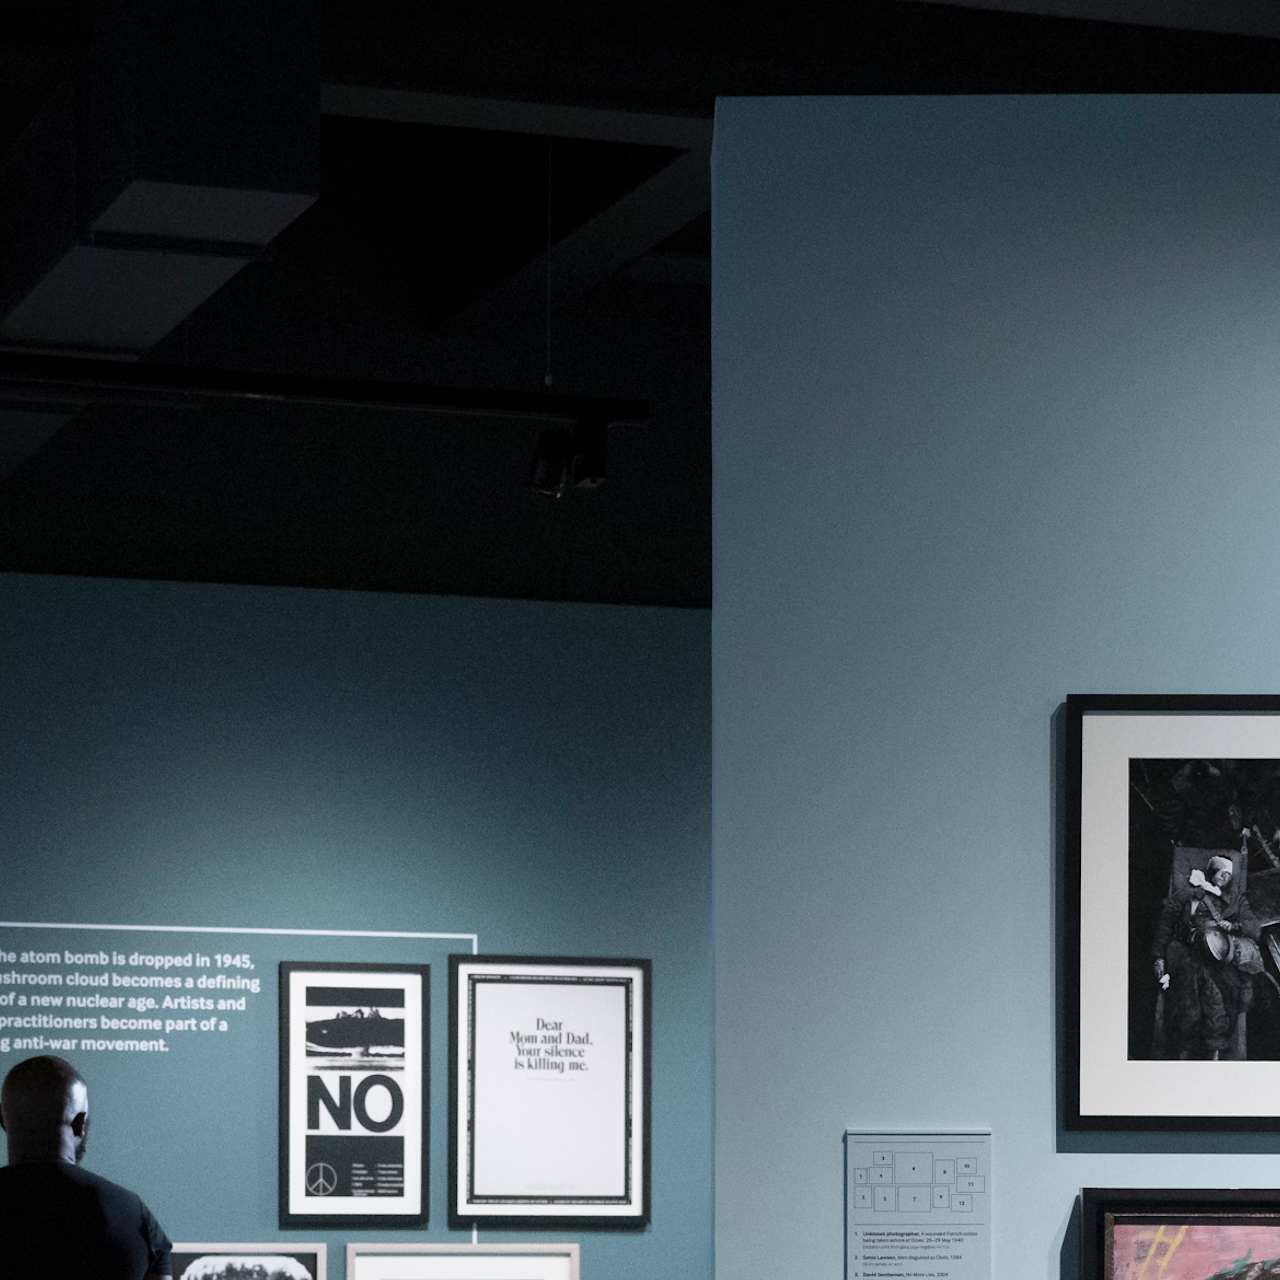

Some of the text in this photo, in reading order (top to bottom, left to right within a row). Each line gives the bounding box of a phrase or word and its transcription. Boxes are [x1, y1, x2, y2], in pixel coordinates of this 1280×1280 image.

[20, 951, 61, 963] atom
[65, 951, 109, 965] bomb
[113, 952, 126, 965] is
[129, 952, 192, 969] dropped
[196, 953, 210, 967] in
[215, 954, 254, 969] 1945,
[66, 973, 108, 986] cloud
[112, 973, 182, 988] becomes
[185, 978, 193, 988] a
[197, 975, 260, 993] defining
[0, 992, 16, 1005] of
[18, 996, 27, 1006] a
[31, 996, 63, 1006] new
[67, 994, 125, 1008] nuclear
[128, 997, 159, 1011] age.
[162, 996, 214, 1010] Artists
[217, 997, 245, 1010] and
[101, 1016, 162, 1030] become
[166, 1018, 197, 1033] part
[200, 1017, 217, 1031] of
[219, 1021, 228, 1031] a
[536, 1017, 563, 1031] Dear
[14, 1036, 78, 1050] anti-war
[81, 1039, 169, 1051] movement.
[510, 1031, 537, 1044] Mom
[541, 1032, 562, 1044] and
[516, 1045, 585, 1057] Your silence
[528, 1058, 565, 1074] killing
[569, 1061, 589, 1071] me.
[307, 1074, 404, 1133] NO
